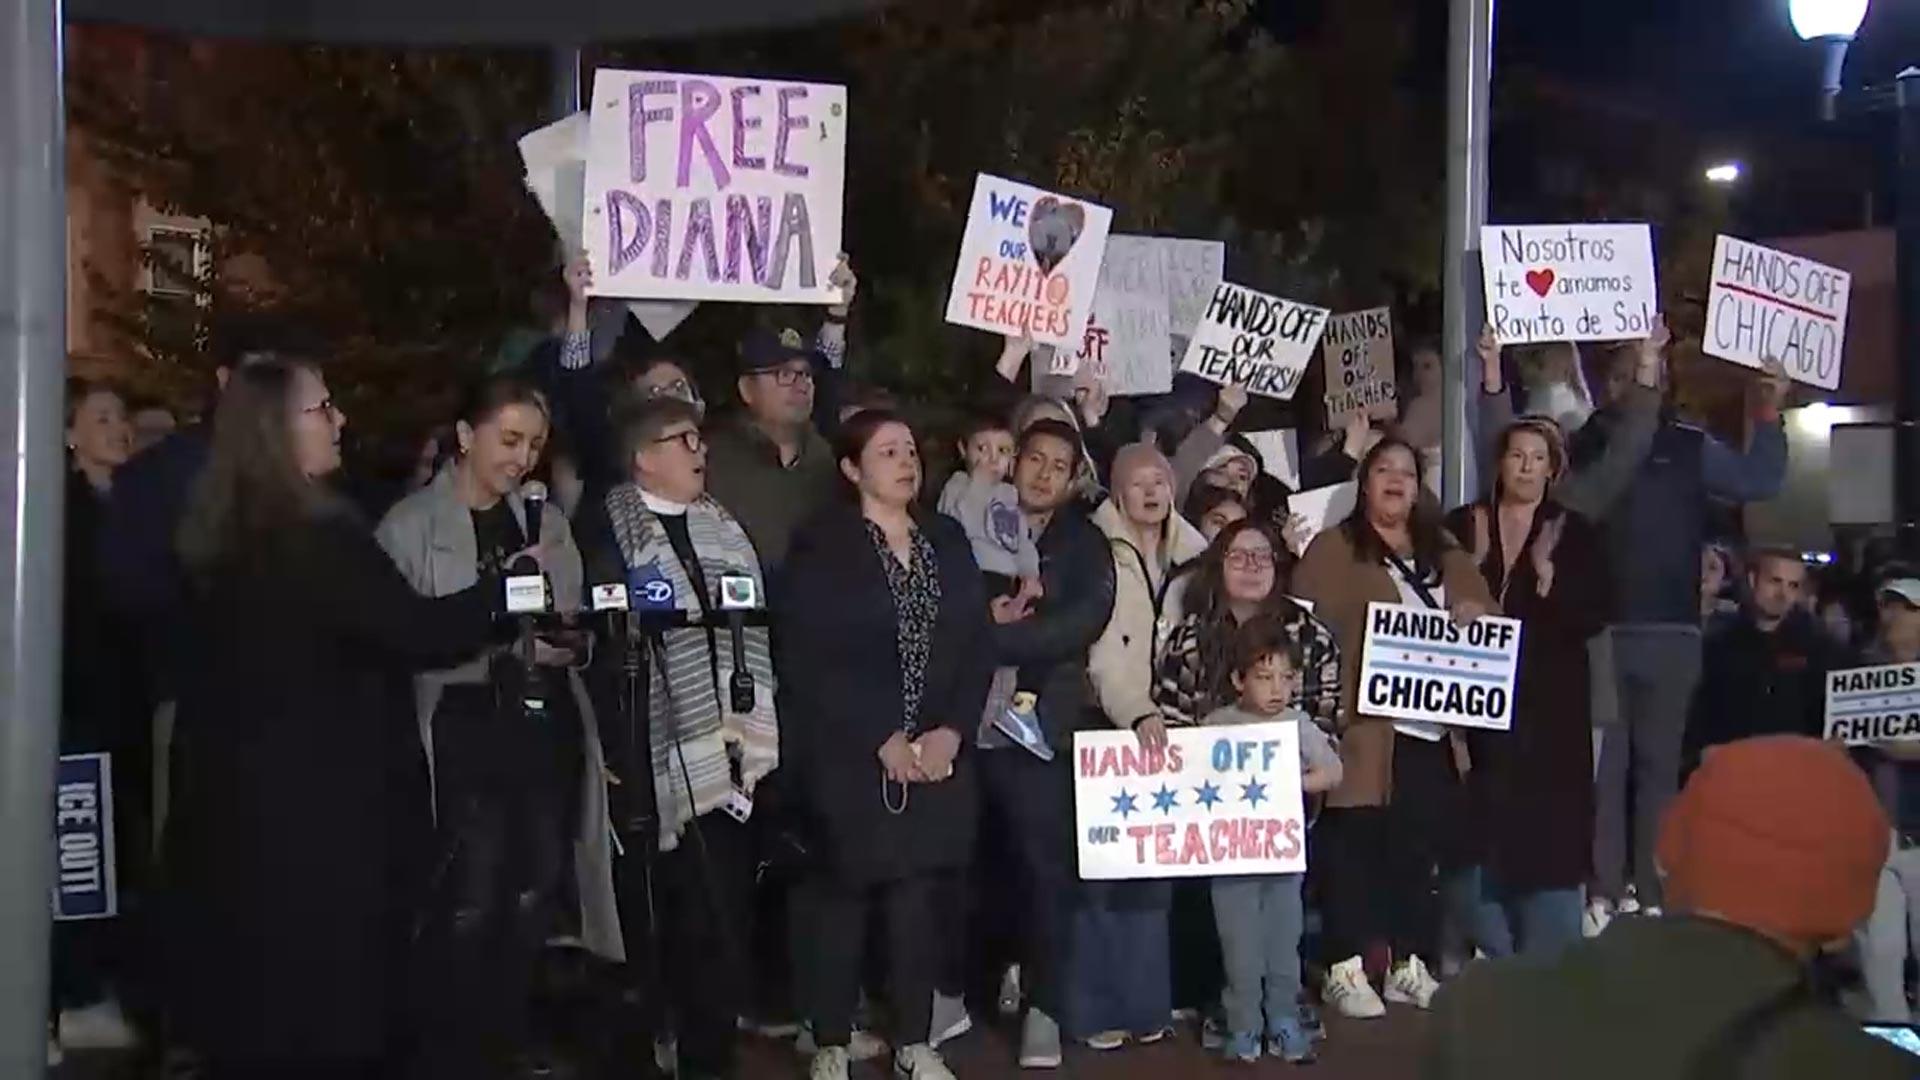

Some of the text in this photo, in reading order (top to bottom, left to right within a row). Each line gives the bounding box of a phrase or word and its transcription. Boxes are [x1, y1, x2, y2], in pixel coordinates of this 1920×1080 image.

[629, 80, 809, 190] FREE
[990, 190, 1029, 228] WE
[606, 189, 817, 290] DIANA
[1000, 239, 1027, 262] OUR
[1501, 229, 1614, 264] Nosotros
[975, 256, 1069, 306] RAYITO
[1494, 272, 1632, 298] te amamos
[1723, 245, 1843, 308] HANDS OFF
[966, 292, 1072, 338] TEACHERS
[1206, 284, 1284, 337] HANDS
[1280, 308, 1325, 345] OFF
[1325, 312, 1388, 346] HANDS
[1494, 302, 1652, 341] Rayito de Sol
[1232, 334, 1275, 361] OUR
[1342, 342, 1369, 368] OFF
[1715, 294, 1837, 381] CHICAGO
[1373, 608, 1513, 649] HANDS OFF
[1368, 673, 1506, 719] CHICAGO
[1832, 667, 1915, 692] HANDS
[1080, 738, 1281, 777] HANDS OFF
[57, 783, 97, 825] ICE
[1088, 817, 1301, 865] OUR TEACHERS
